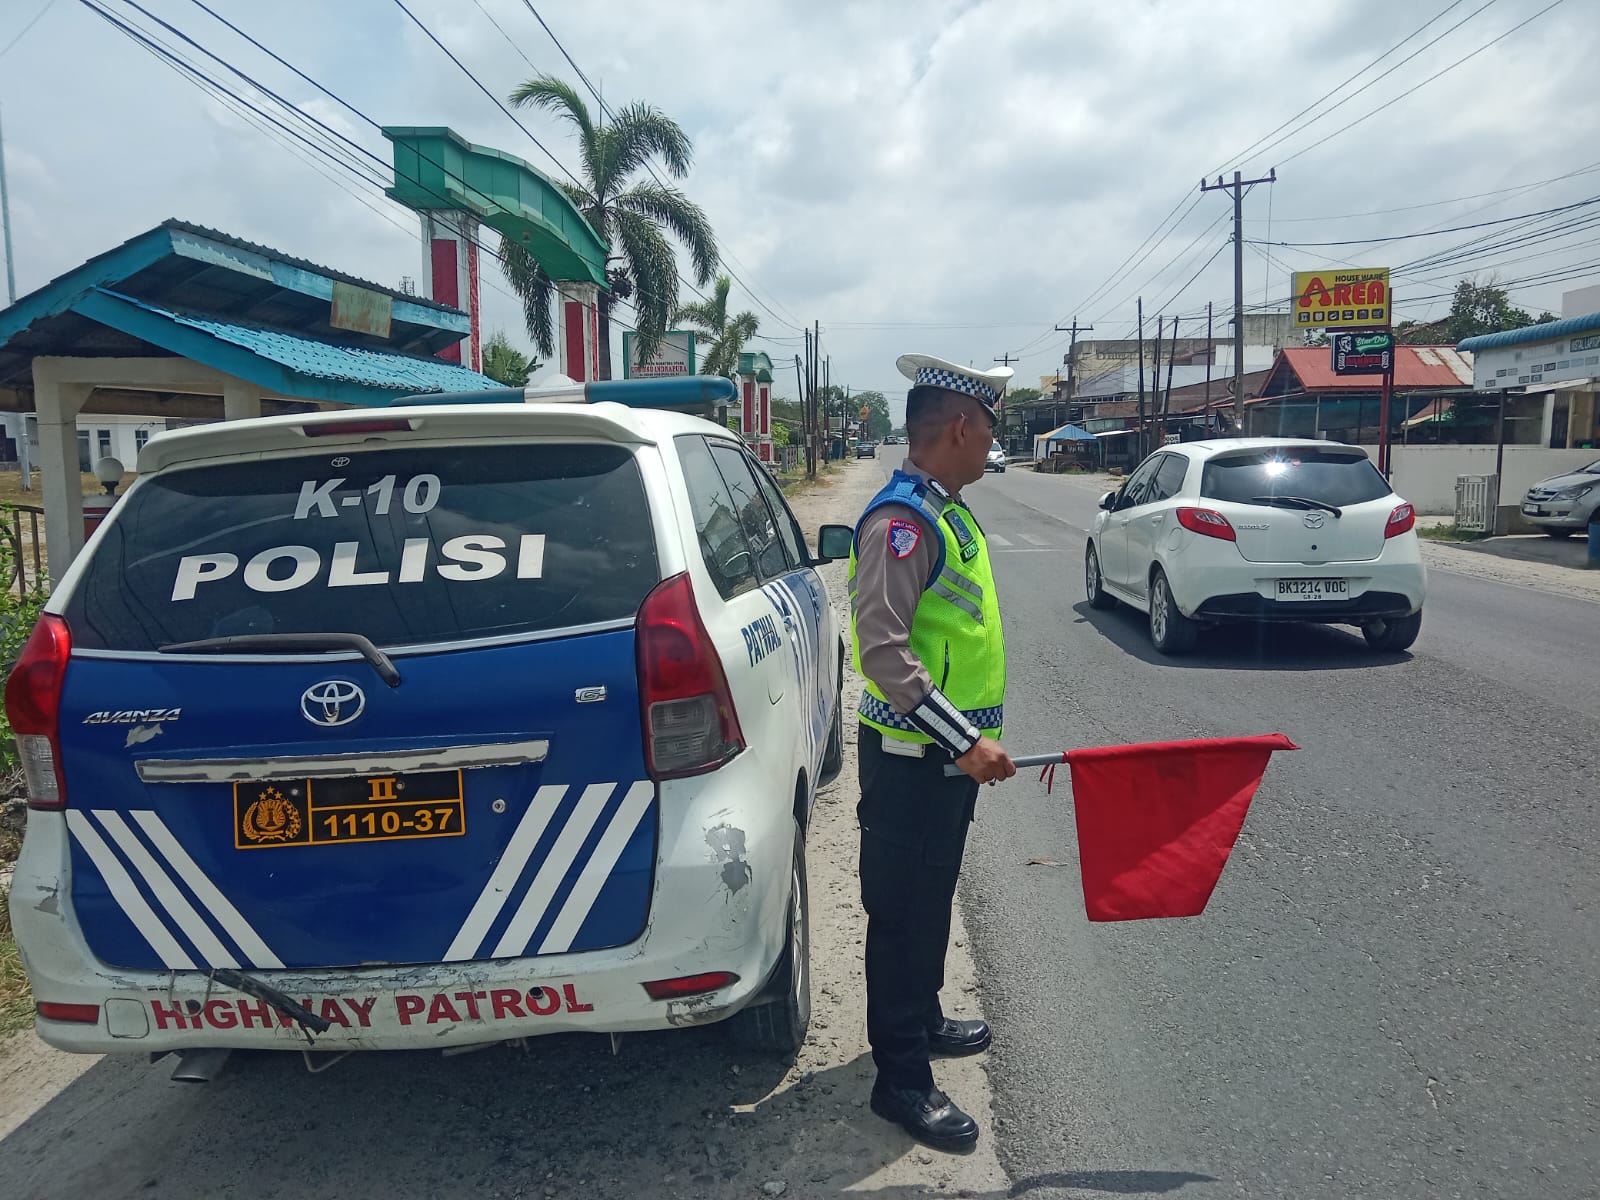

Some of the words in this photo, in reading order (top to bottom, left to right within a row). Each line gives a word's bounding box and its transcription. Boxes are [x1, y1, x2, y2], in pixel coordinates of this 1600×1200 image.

[1298, 277, 1385, 308] AREA
[1335, 274, 1360, 282] HOUSE
[293, 473, 442, 520] K-10
[171, 534, 546, 601] POLISI
[82, 707, 182, 724] AVANZA
[367, 778, 398, 800] II
[323, 808, 454, 837] 1110-37
[394, 983, 594, 1026] PATROL
